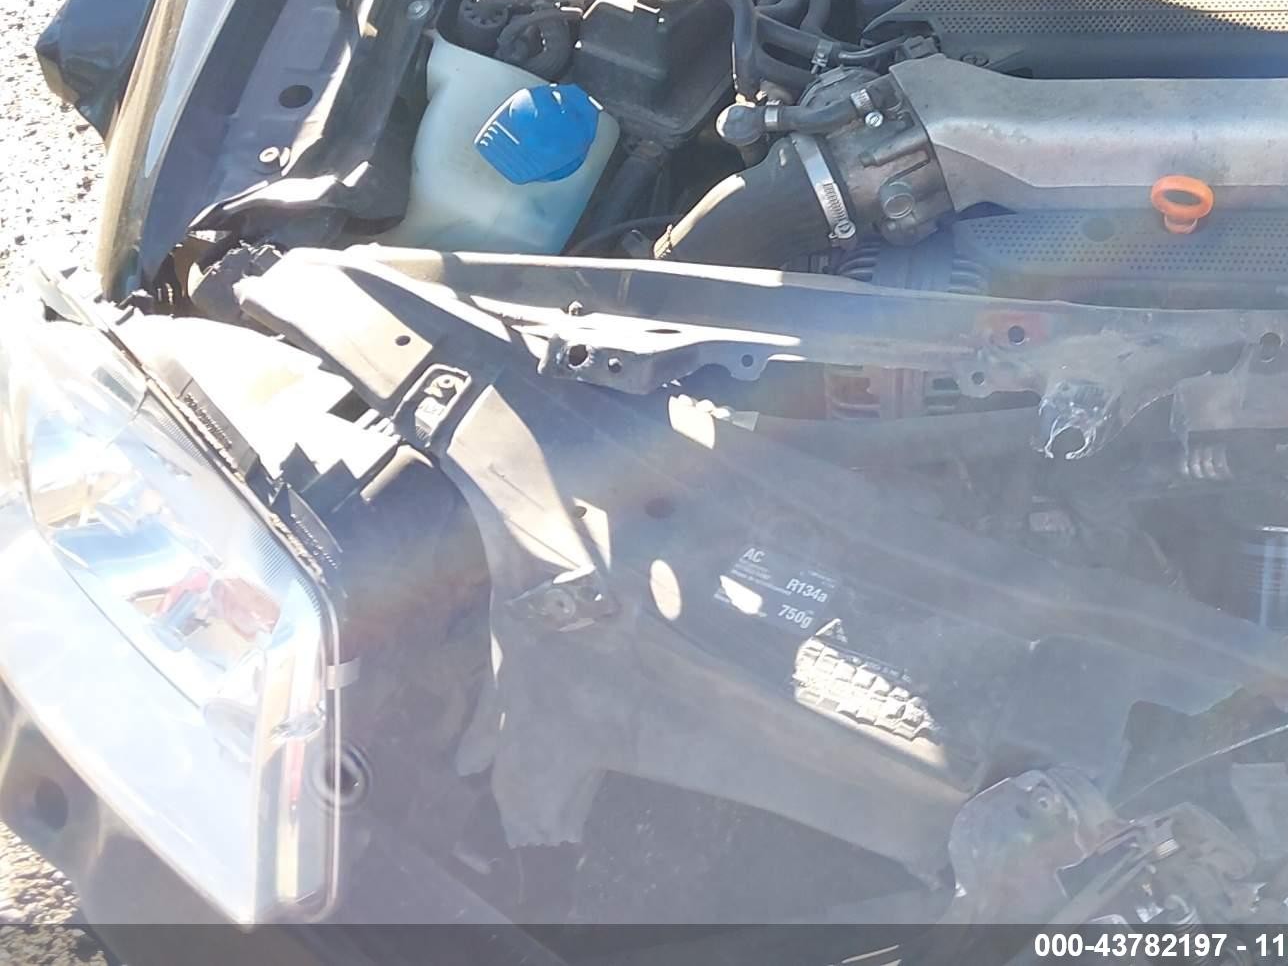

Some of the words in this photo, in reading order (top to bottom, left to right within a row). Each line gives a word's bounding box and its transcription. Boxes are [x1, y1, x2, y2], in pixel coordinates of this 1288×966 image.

[743, 547, 765, 563] AC
[786, 578, 828, 603] R134a
[778, 604, 814, 629] 750g
